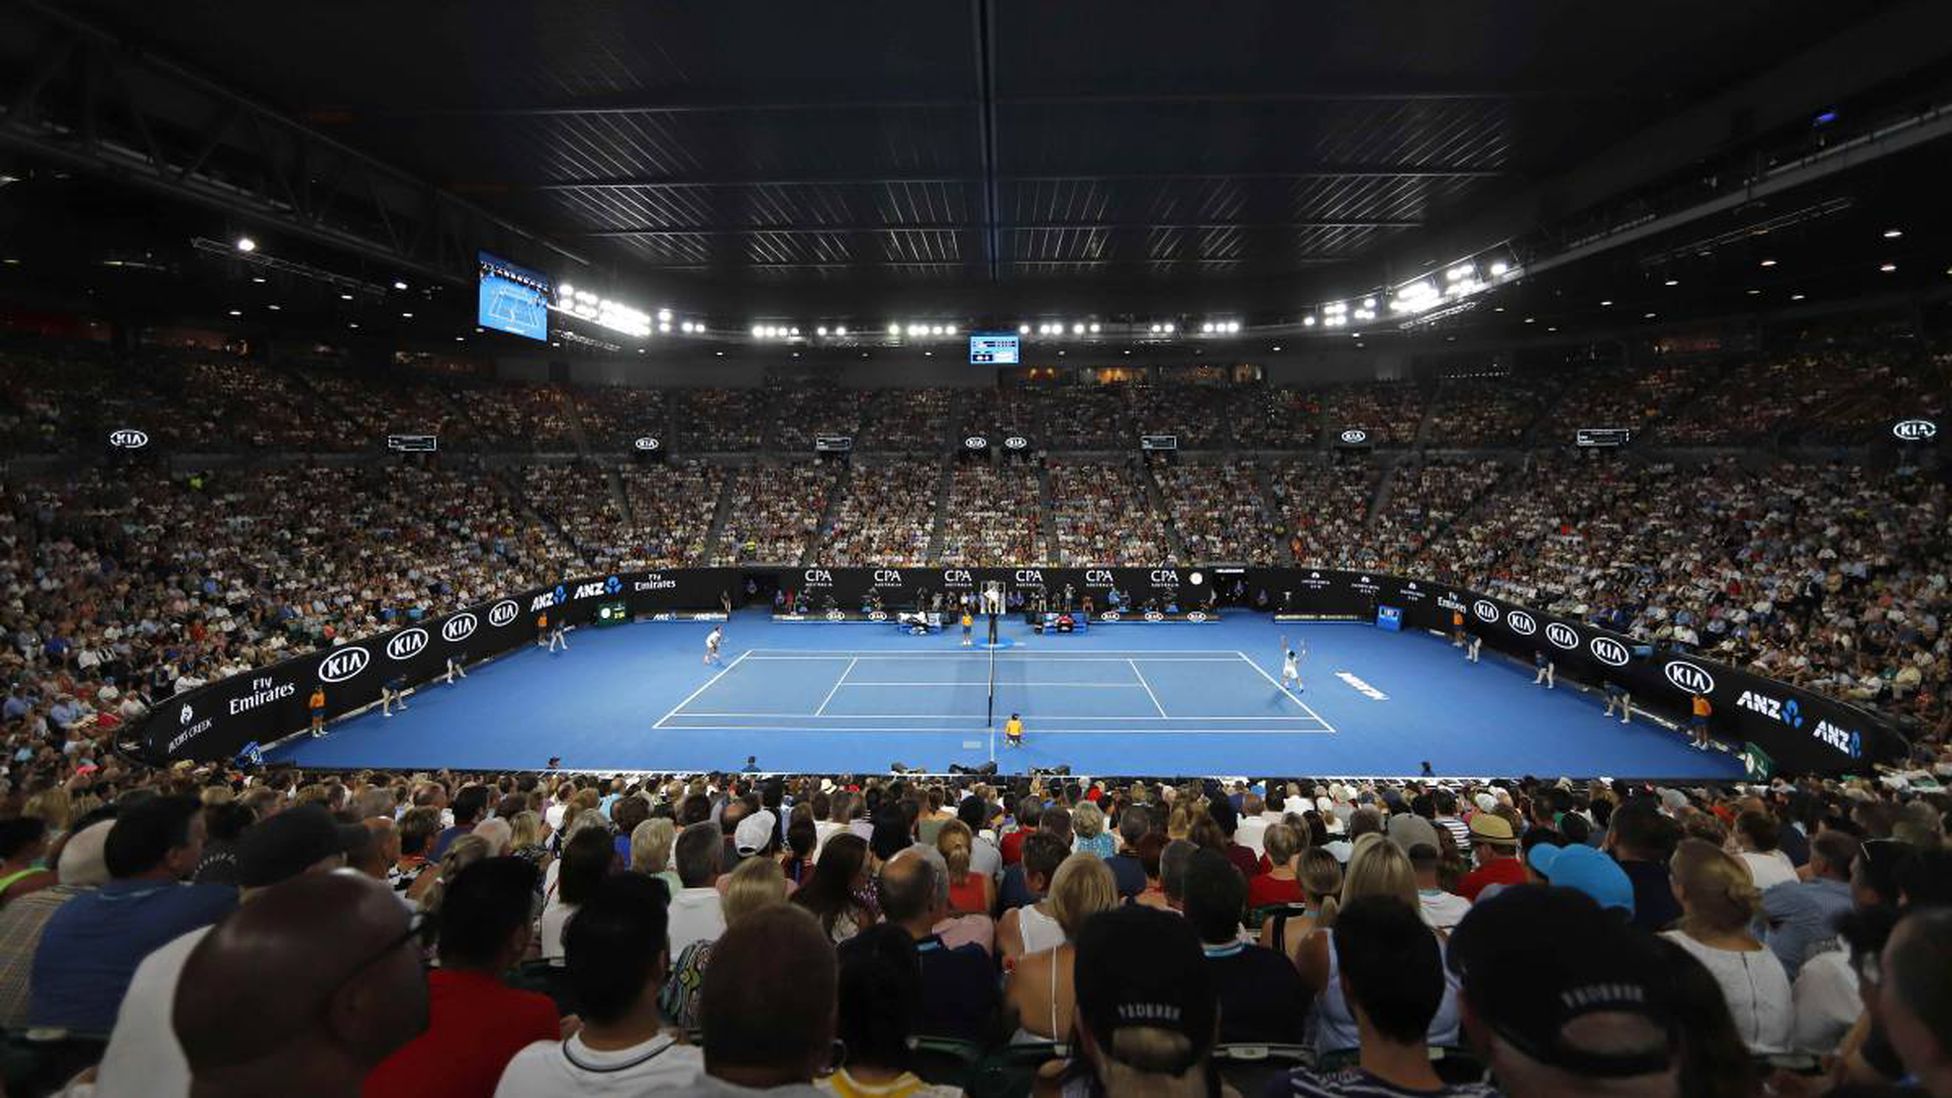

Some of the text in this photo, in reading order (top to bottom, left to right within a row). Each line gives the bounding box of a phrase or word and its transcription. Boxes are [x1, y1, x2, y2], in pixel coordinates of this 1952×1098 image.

[115, 432, 142, 445] KIA
[1900, 424, 1929, 437] KIA
[805, 570, 832, 582] CPA
[874, 570, 901, 582] CPA
[944, 570, 973, 582] CPA
[1016, 570, 1043, 582] CPA
[1086, 570, 1114, 582] CPA
[1151, 570, 1178, 582] CPA
[573, 582, 605, 599] ANZ
[530, 591, 554, 612] ANZ
[493, 603, 515, 623] KIA
[1511, 613, 1532, 632] KIA
[447, 617, 473, 639] KIA
[1550, 625, 1574, 646] KIA
[393, 633, 424, 657] KIA
[1595, 640, 1624, 663] KIA
[326, 651, 363, 679] KIA
[1671, 665, 1706, 691] KIA
[229, 682, 295, 715] Emirates
[1736, 690, 1781, 720] ANZ
[1812, 719, 1850, 754] ANZ
